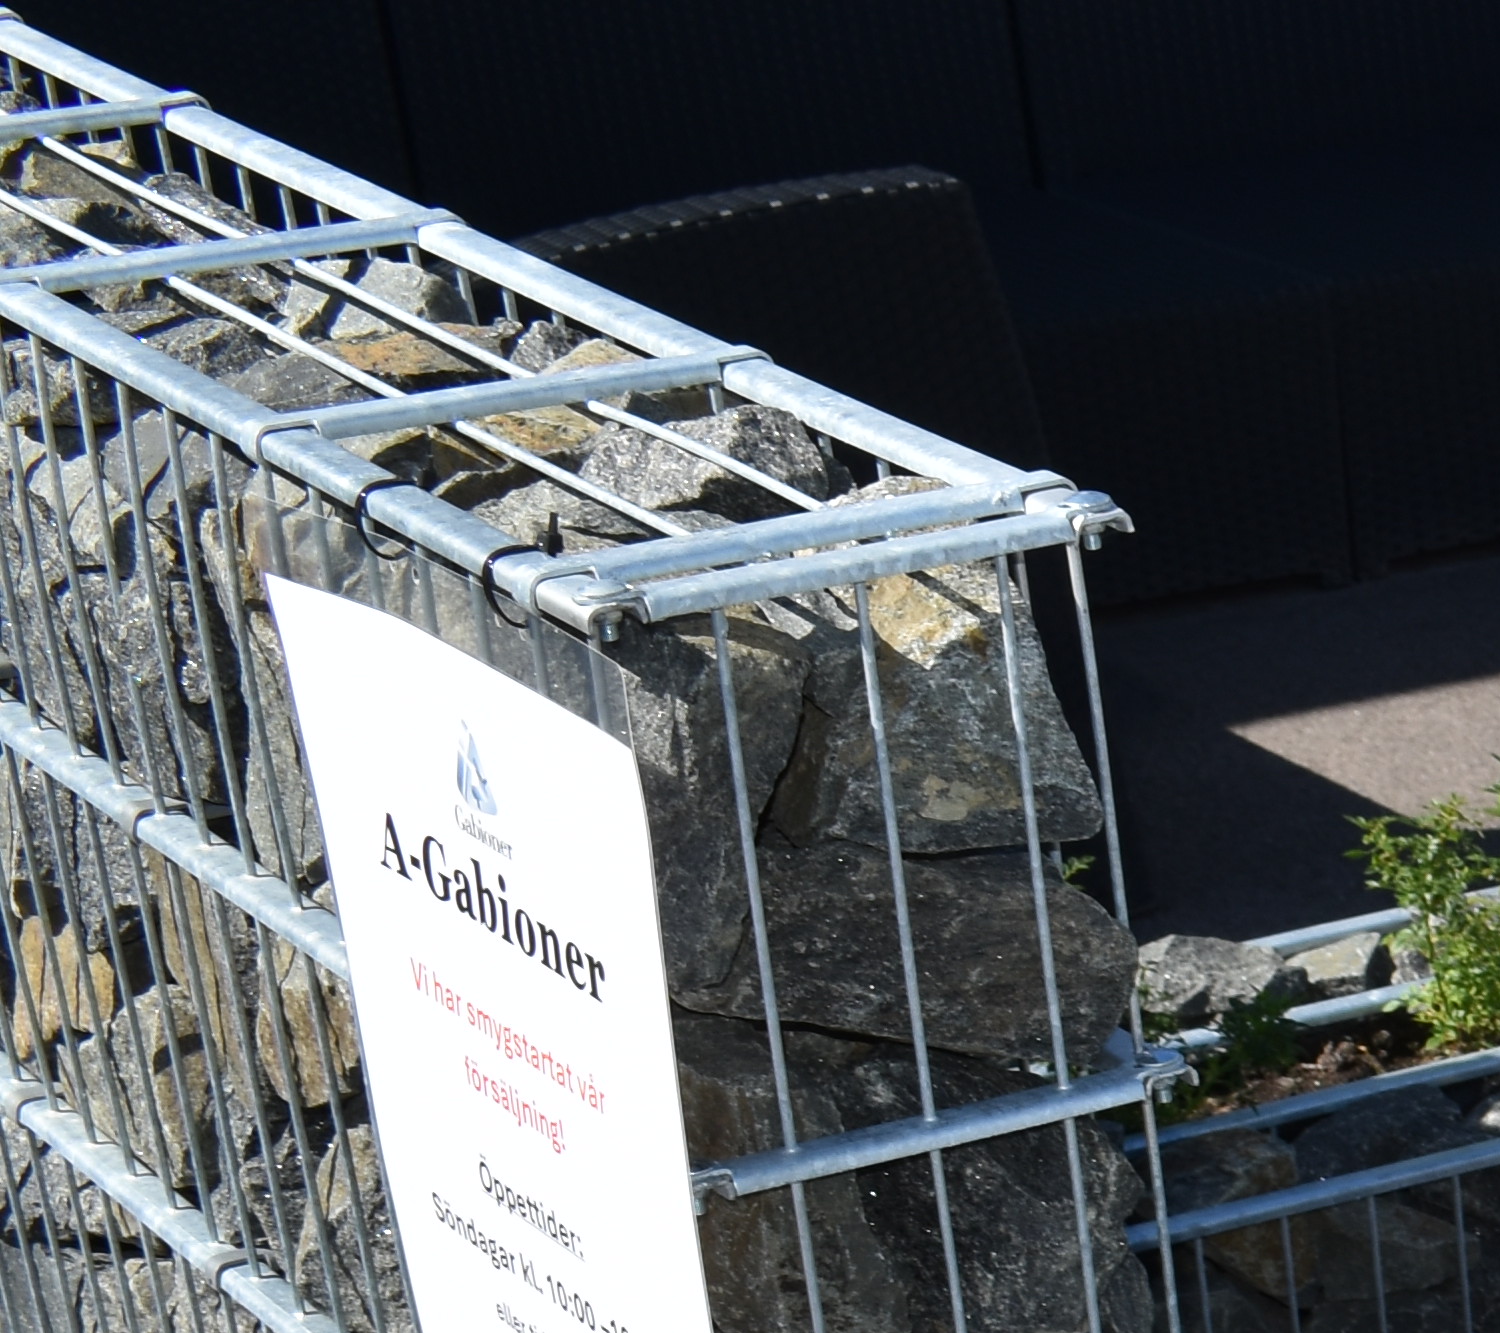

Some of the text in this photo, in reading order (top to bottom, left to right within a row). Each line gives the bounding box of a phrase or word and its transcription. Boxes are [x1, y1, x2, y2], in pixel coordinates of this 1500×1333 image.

[455, 804, 513, 861] Gabioner
[381, 812, 606, 1003] A-Gabioner
[409, 957, 605, 1114] Vi har smygstartat vår
[464, 1055, 567, 1154] försäljning!
[432, 1191, 516, 1275] Söndagar
[546, 1275, 596, 1332] 10:00
[479, 1153, 585, 1261] Öppettider:
